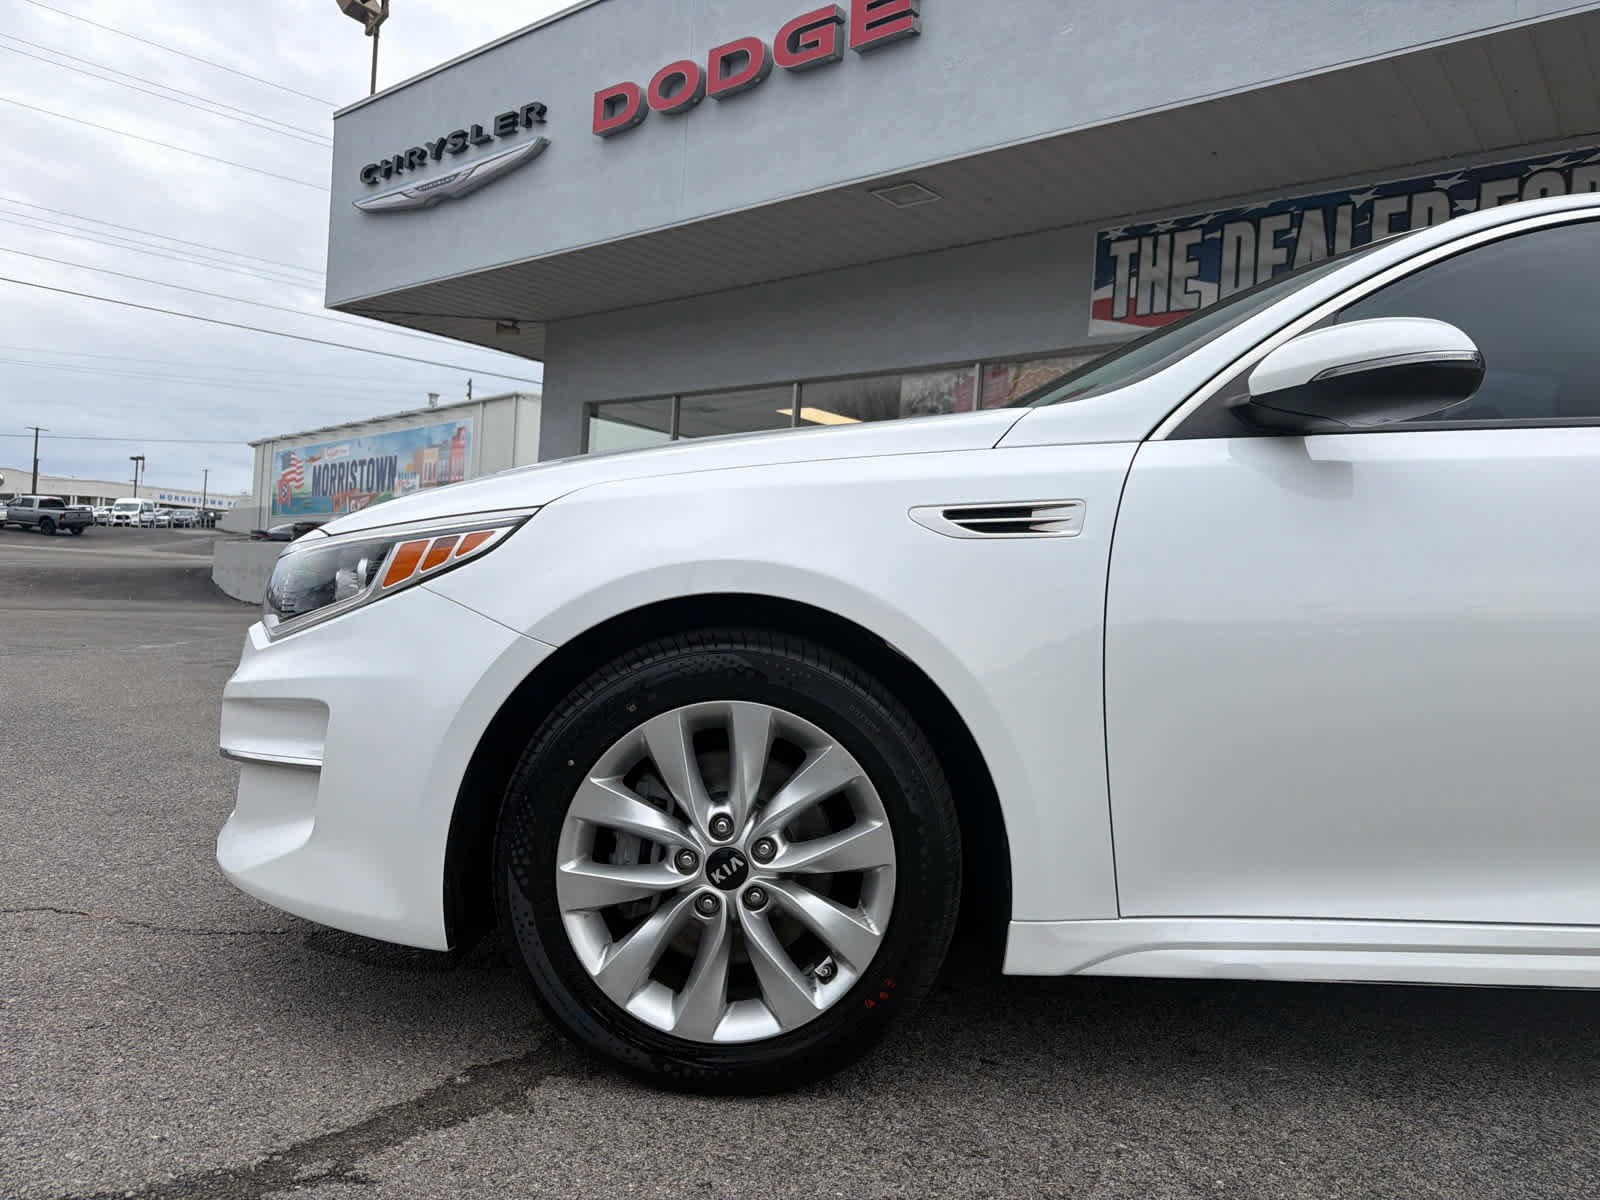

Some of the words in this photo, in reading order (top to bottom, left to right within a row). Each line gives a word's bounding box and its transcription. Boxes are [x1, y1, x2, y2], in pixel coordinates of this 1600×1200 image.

[592, 0, 919, 138] DODGE
[360, 102, 547, 184] CHRYSLER
[1110, 229, 1202, 319] THE
[311, 455, 398, 497] MORRISTOWN
[710, 856, 745, 884] KIA
